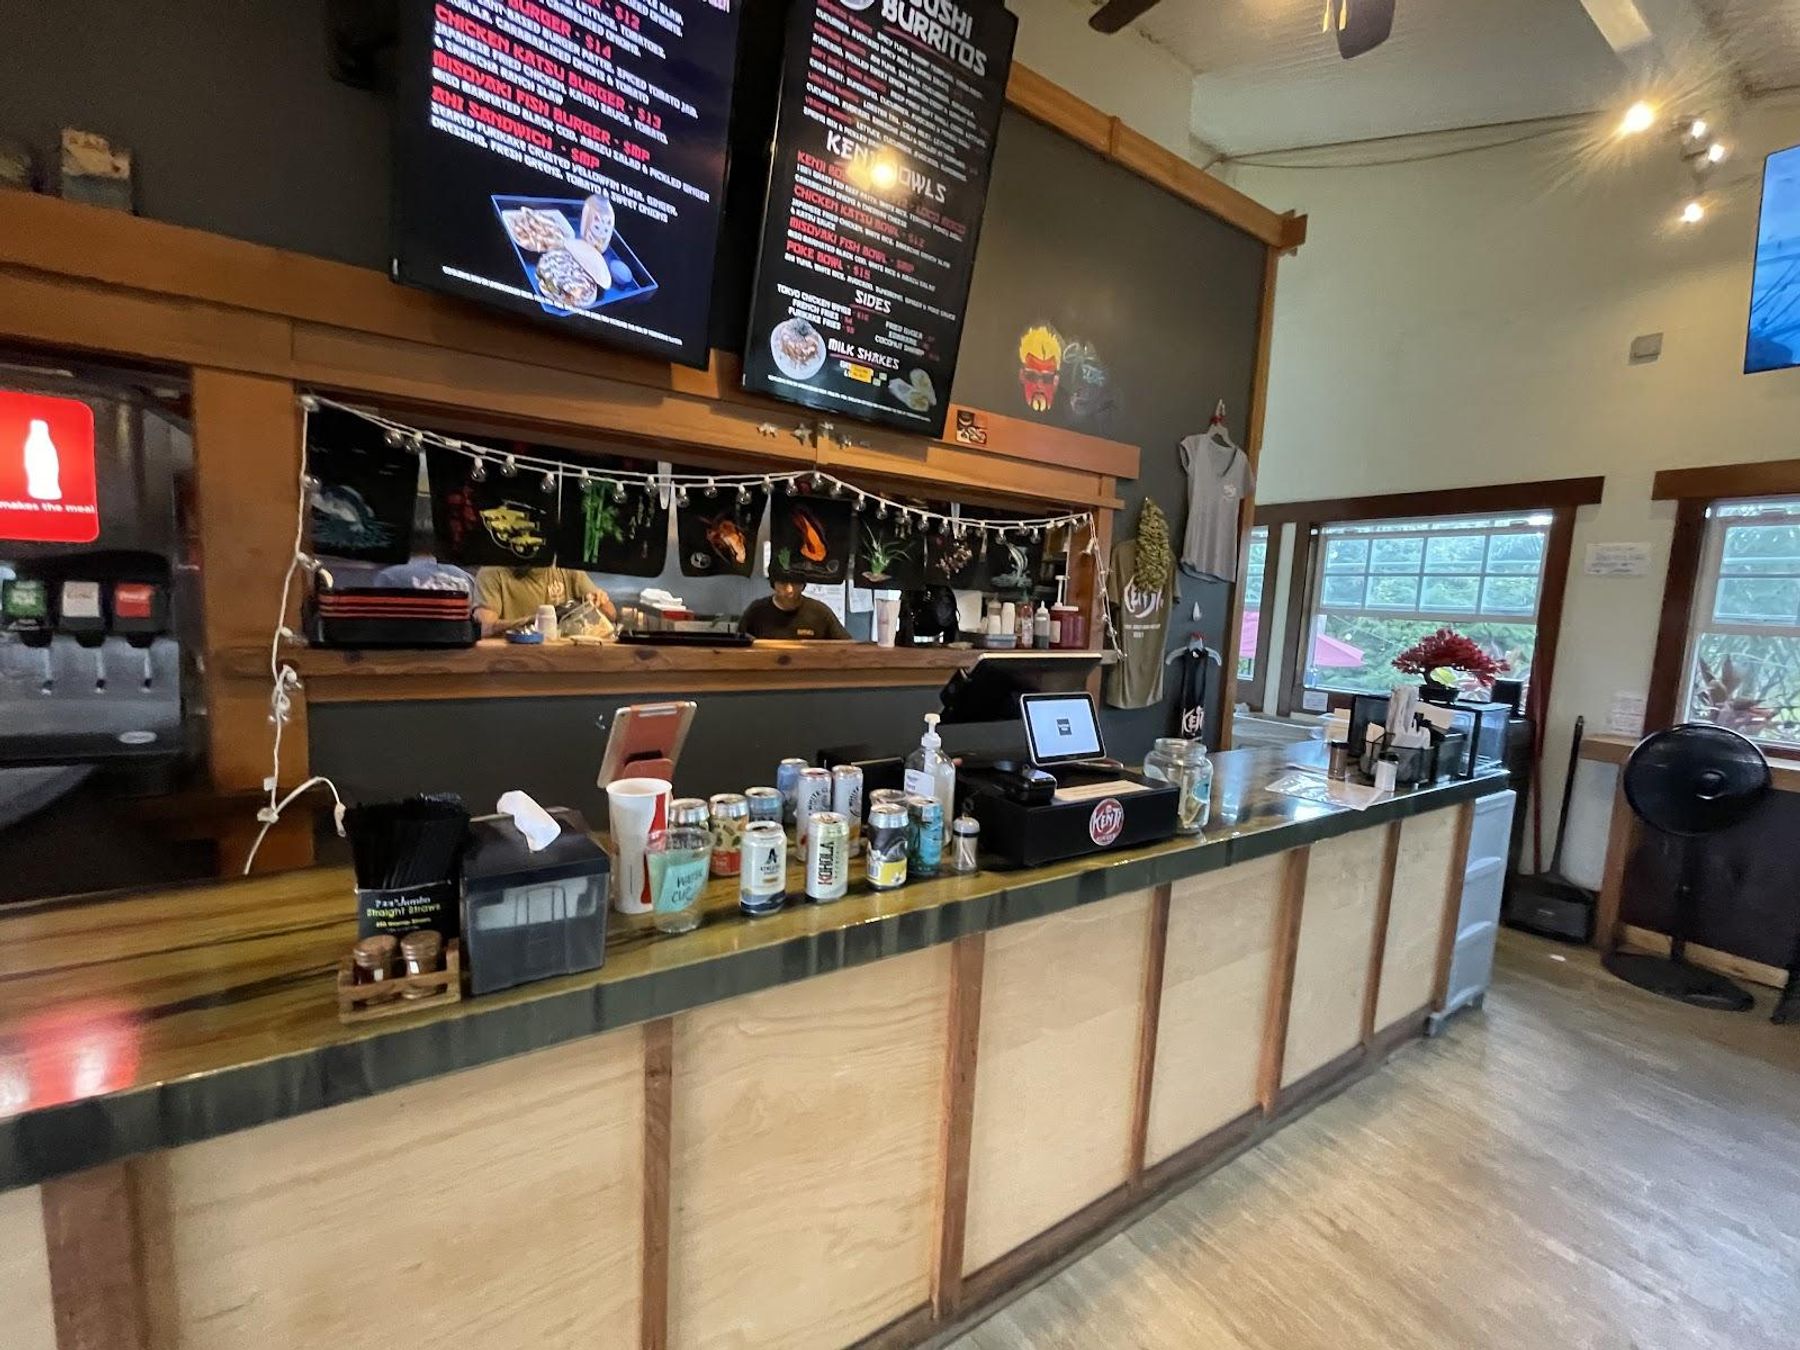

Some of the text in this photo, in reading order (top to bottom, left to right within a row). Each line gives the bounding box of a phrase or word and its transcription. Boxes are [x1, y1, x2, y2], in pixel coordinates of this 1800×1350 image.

[615, 6, 639, 30] $12
[586, 34, 610, 59] $14
[881, 0, 986, 76] BURRITOS
[435, 4, 660, 129] CHICKEN KATSU BURGER $13
[434, 50, 511, 99] MISOYAKI
[516, 89, 549, 116] FISH
[553, 107, 610, 145] BURGER
[432, 86, 464, 111] AHI
[468, 101, 552, 150] SANDWICH
[794, 185, 838, 212] CHICKEN
[840, 204, 872, 226] KATSU
[787, 240, 814, 259] POKE
[817, 252, 842, 270] BOWL
[790, 217, 886, 263] MISOYAKI FISH BOWL
[855, 290, 891, 313] SIDES
[828, 338, 899, 369] MILK SHAKES
[43, 501, 64, 513] the
[65, 503, 96, 514] meal
[366, 902, 441, 919] Straight Straws
